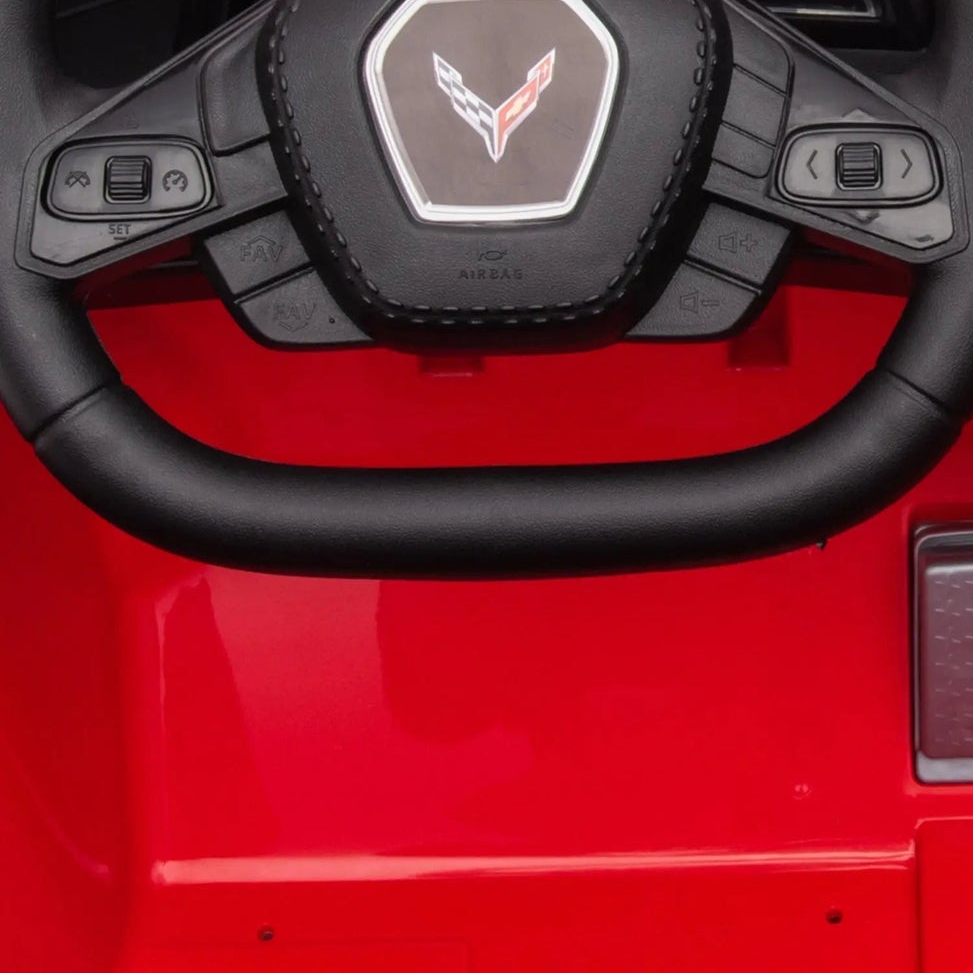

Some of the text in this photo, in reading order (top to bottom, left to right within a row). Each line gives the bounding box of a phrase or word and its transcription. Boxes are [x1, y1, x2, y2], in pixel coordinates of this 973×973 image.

[108, 223, 131, 235] SET
[240, 243, 284, 263] FAV
[458, 268, 523, 280] AIRBAG
[274, 301, 317, 321] FAV
